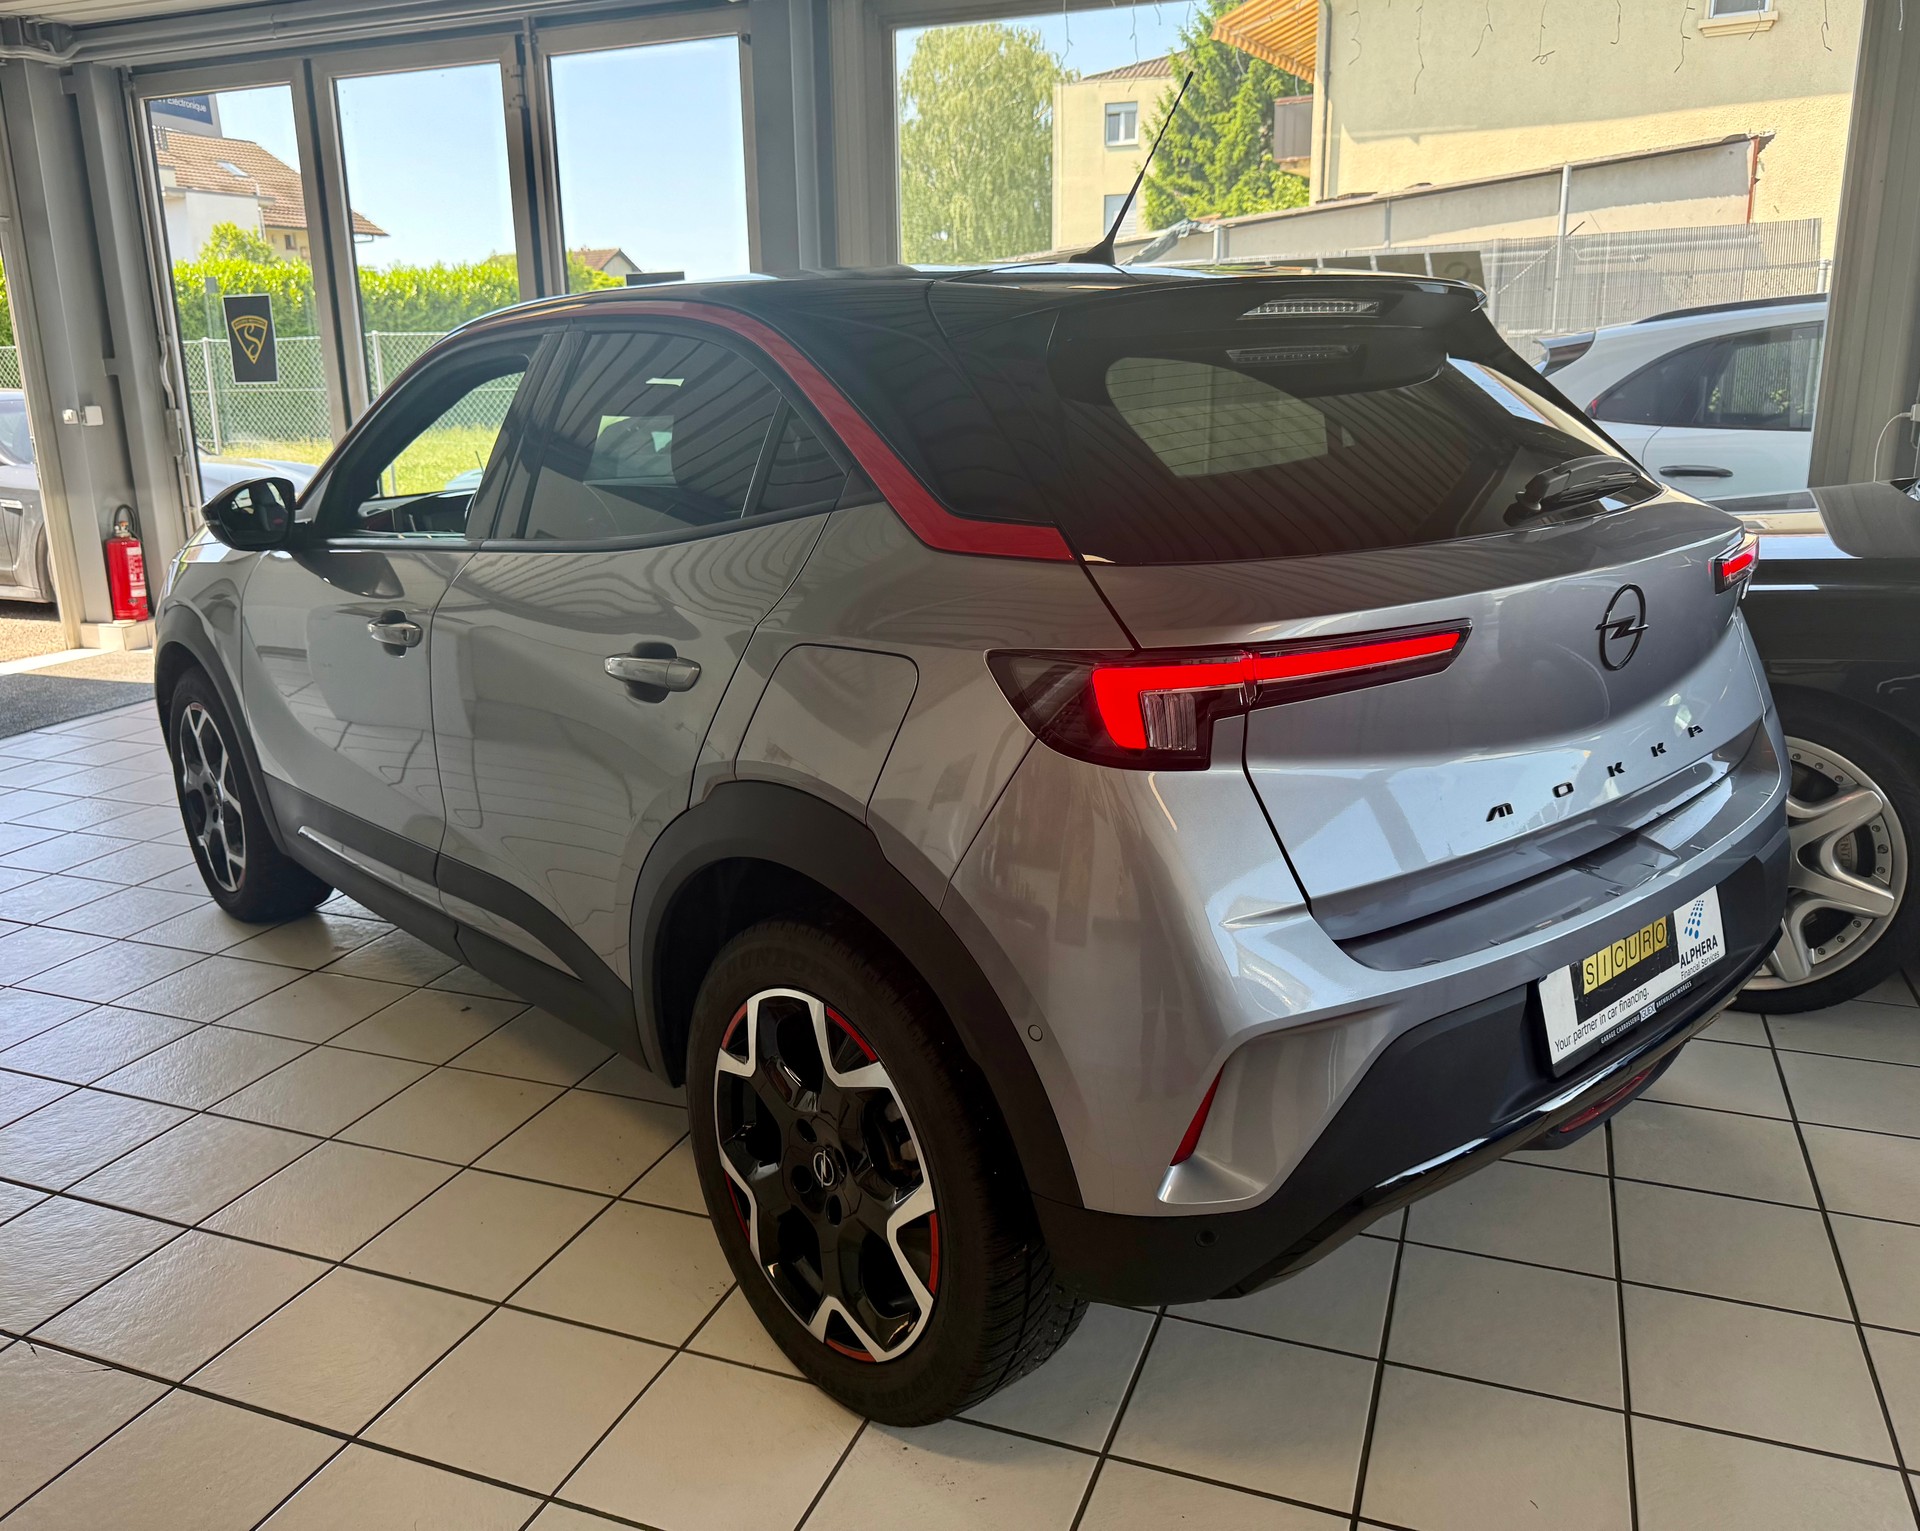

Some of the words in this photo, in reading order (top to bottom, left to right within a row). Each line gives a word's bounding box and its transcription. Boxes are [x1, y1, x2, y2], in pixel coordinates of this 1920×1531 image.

[1486, 725, 1704, 822] MOKKA
[1585, 922, 1666, 985] SICURO
[1680, 934, 1719, 969] ALPHERA
[1680, 961, 1701, 980] Financial
[1701, 950, 1720, 968] Services
[1554, 1034, 1573, 1053] Your
[1573, 1017, 1598, 1046] partner
[1599, 1013, 1607, 1026] in
[1607, 1004, 1618, 1021] car
[1618, 986, 1650, 1013] financing.
[1600, 1030, 1617, 1044] GARAGE
